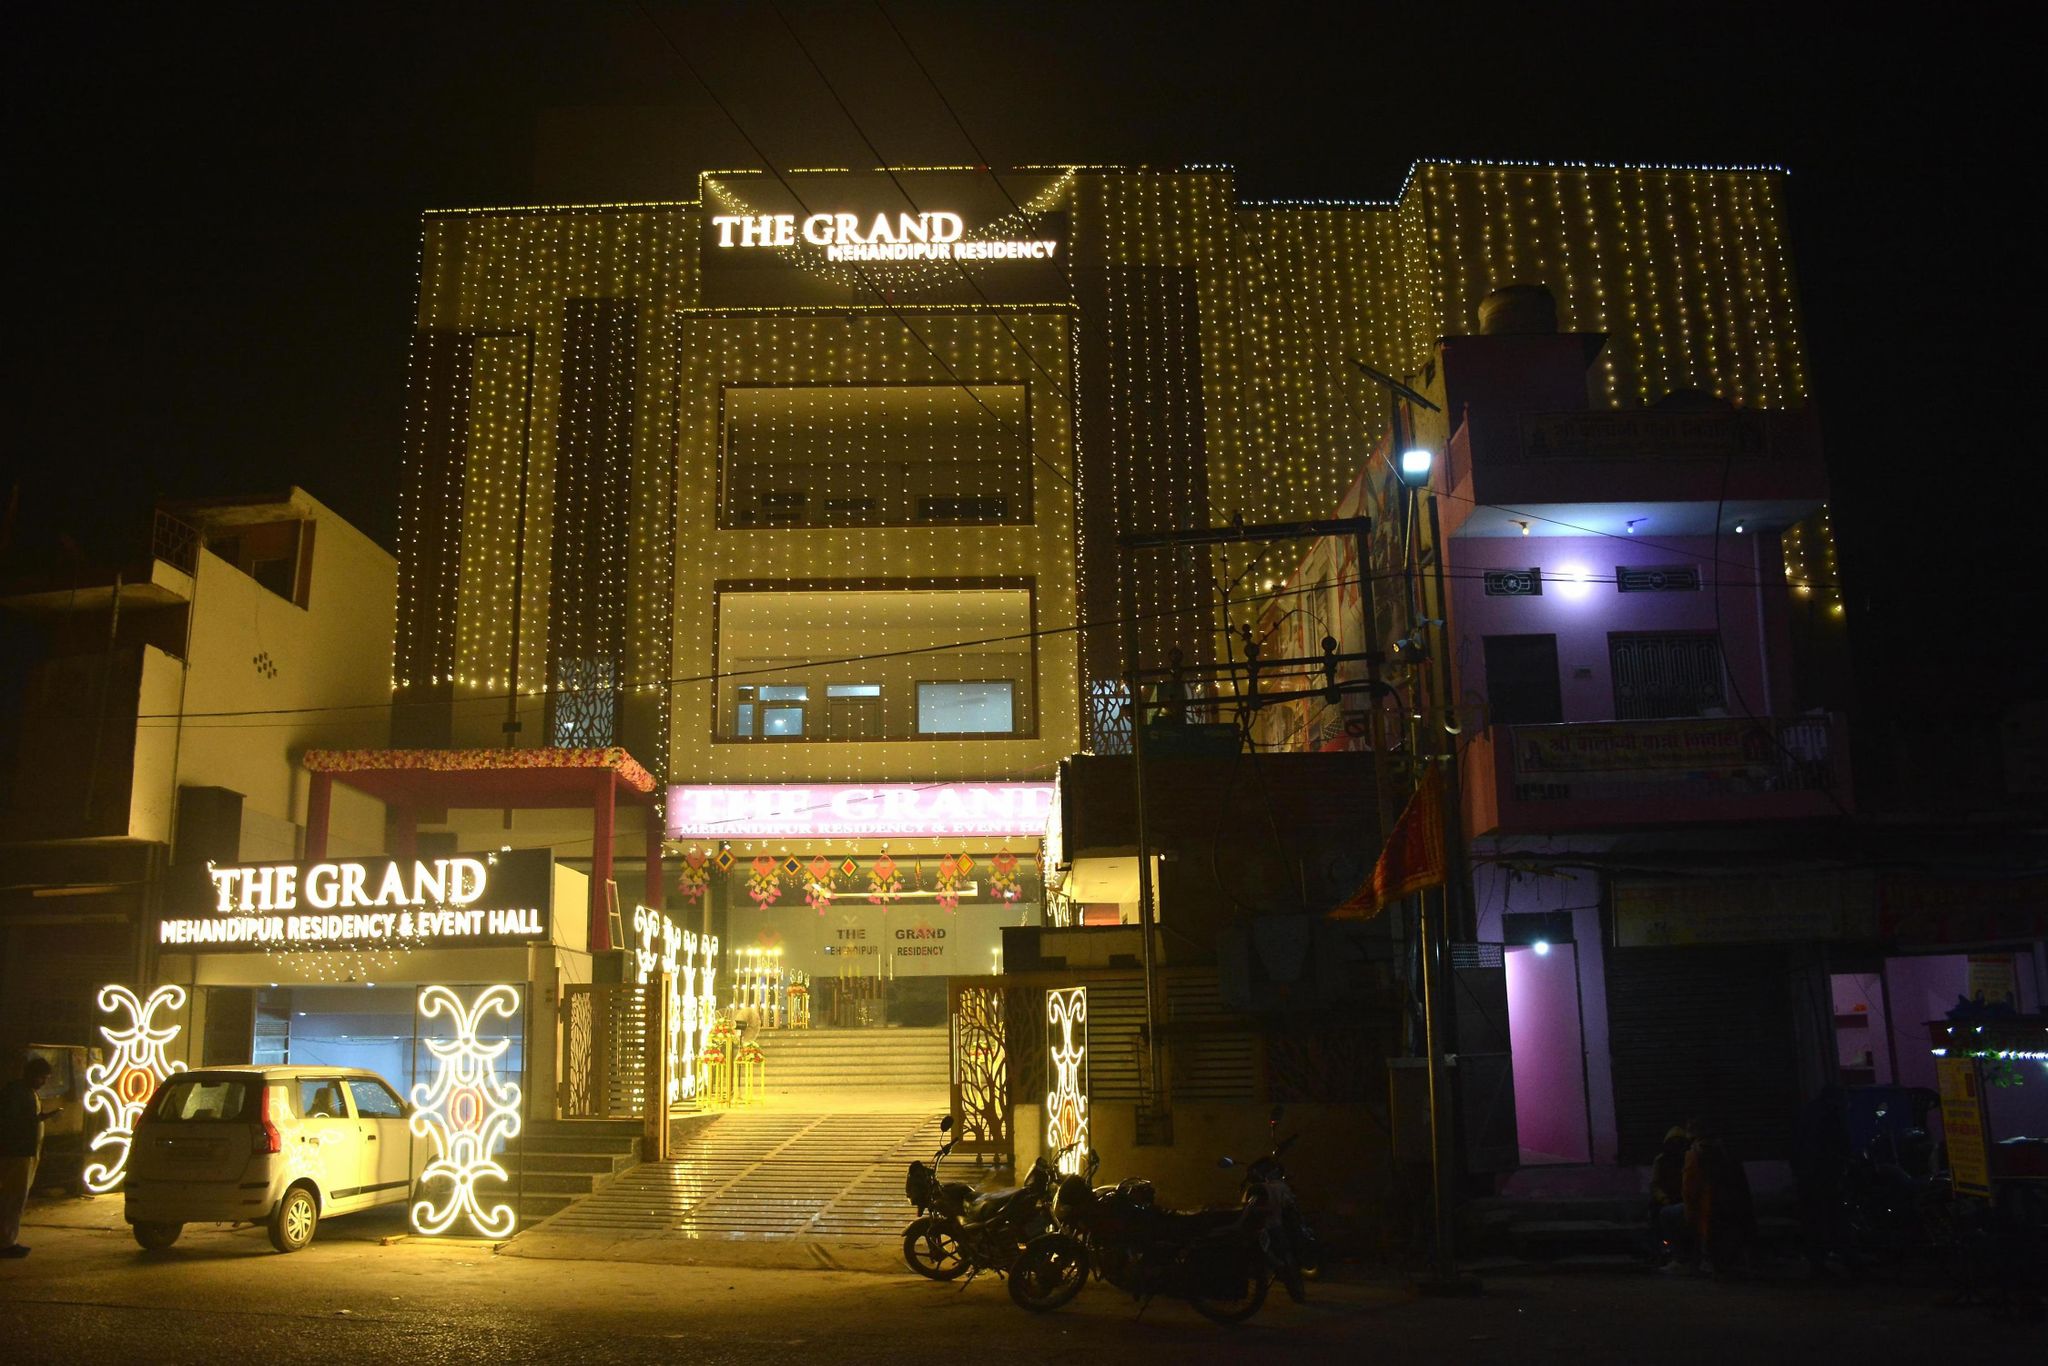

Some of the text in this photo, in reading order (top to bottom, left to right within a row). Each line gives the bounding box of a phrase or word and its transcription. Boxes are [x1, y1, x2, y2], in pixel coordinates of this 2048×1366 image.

[713, 211, 964, 248] THE GRAND
[828, 241, 1056, 262] MEHANDIPUR RESIDENCY
[683, 788, 1055, 821] THE GRAND
[680, 822, 813, 834] MEHANDIPUR
[818, 821, 924, 833] RESIDENCY
[932, 821, 948, 833] &
[952, 820, 1014, 833] EVENT
[211, 858, 488, 912] THE GRAND
[160, 908, 543, 944] MEHANDIPUR RESIDENCY & EVENT HALL
[837, 928, 946, 941] THE GRAND
[824, 945, 945, 956] EHDIPUR RESIDENCY
